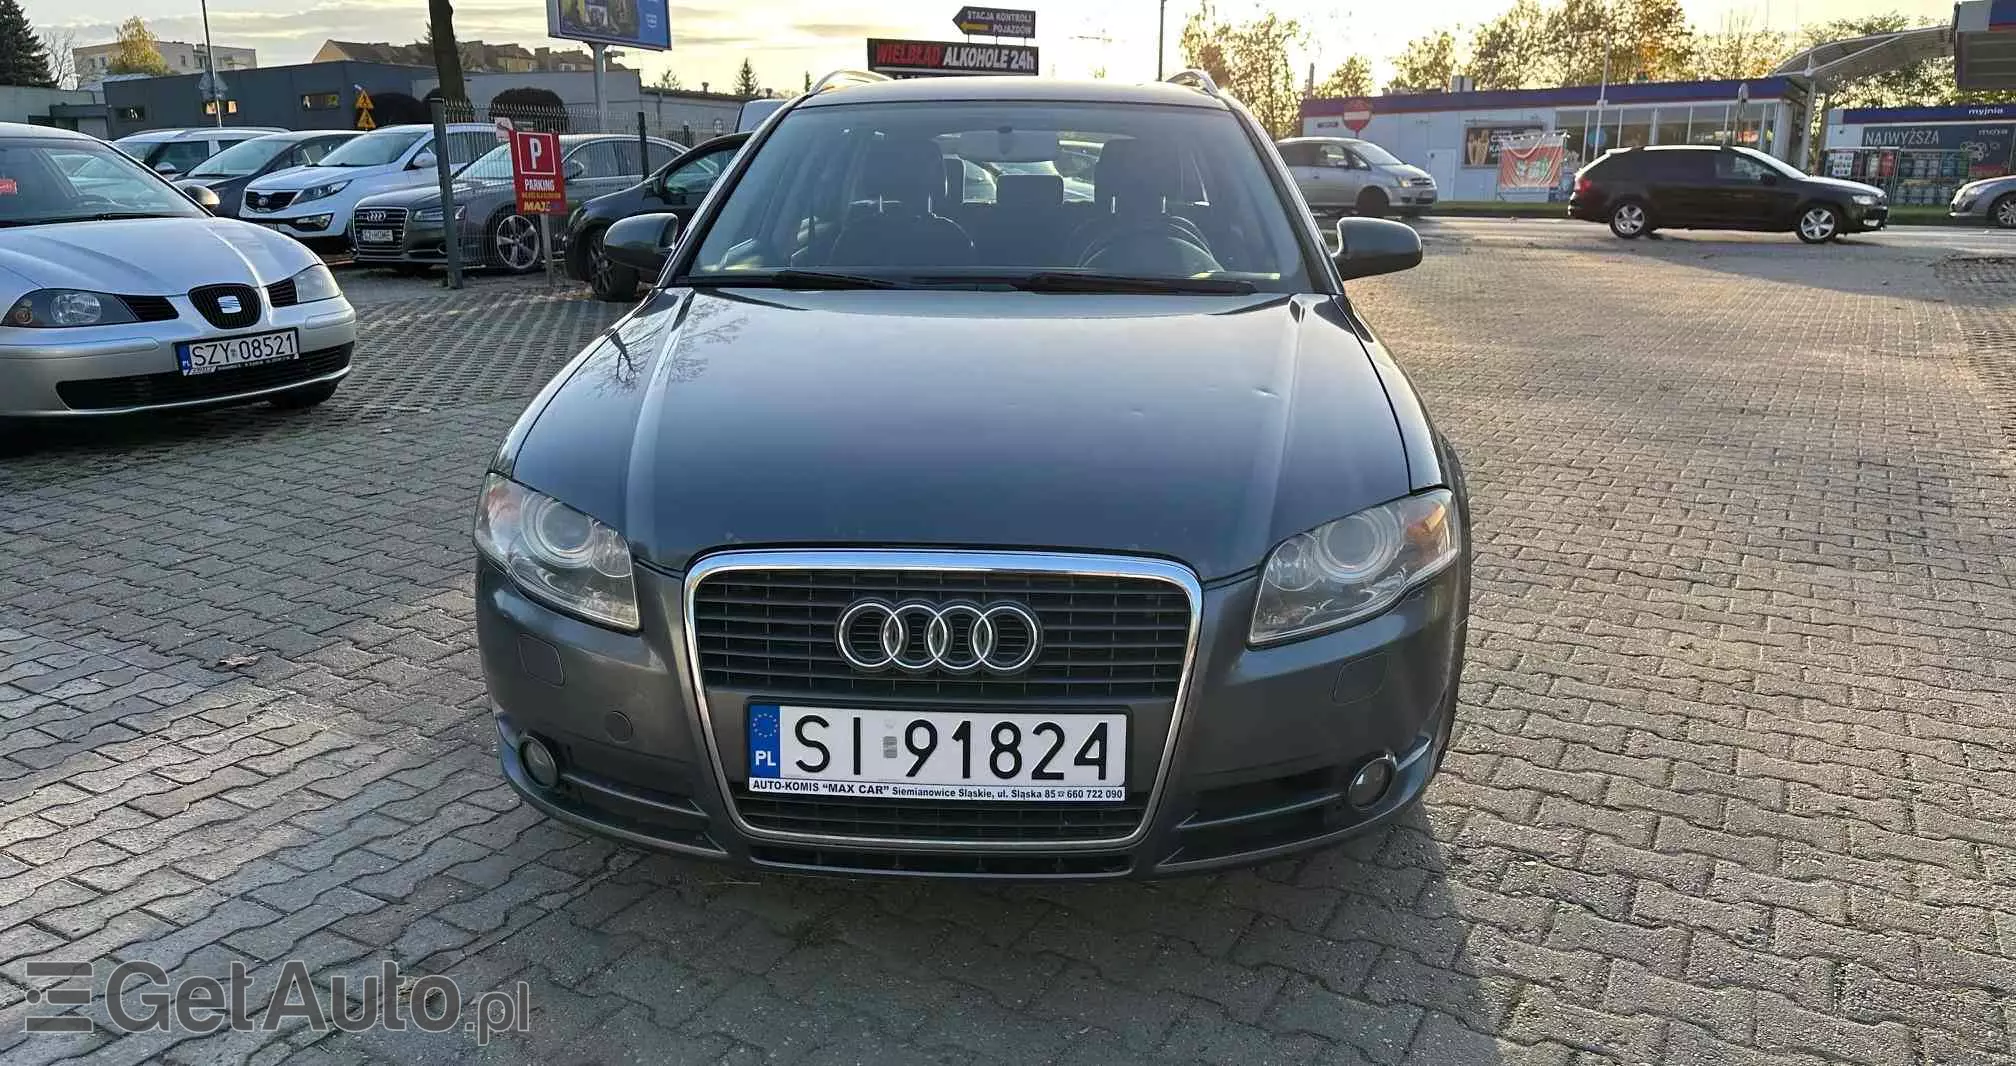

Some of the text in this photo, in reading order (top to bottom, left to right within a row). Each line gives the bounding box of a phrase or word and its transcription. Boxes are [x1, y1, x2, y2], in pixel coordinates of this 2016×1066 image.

[967, 10, 1032, 23] STACJA KONTROLI
[992, 23, 1032, 35] POJAZDÓW
[943, 47, 1008, 68] ALKOHOLE
[1009, 51, 1034, 69] 24h
[1968, 107, 2004, 116] myjnia
[1865, 128, 1939, 146] NAJWYŻSZA
[529, 137, 543, 170] P
[524, 178, 555, 192] PARKING
[192, 342, 231, 367] SZY
[239, 333, 295, 360] 08521
[794, 714, 1109, 781] SI 91824
[755, 751, 777, 766] PL
[752, 779, 819, 792] AUTO-KOMIS
[892, 786, 956, 798] Siemianowice
[997, 788, 1008, 798] ul.
[1044, 788, 1056, 799] 85
[1066, 789, 1084, 799] 660
[1086, 789, 1103, 799] 722
[1105, 789, 1123, 799] 090
